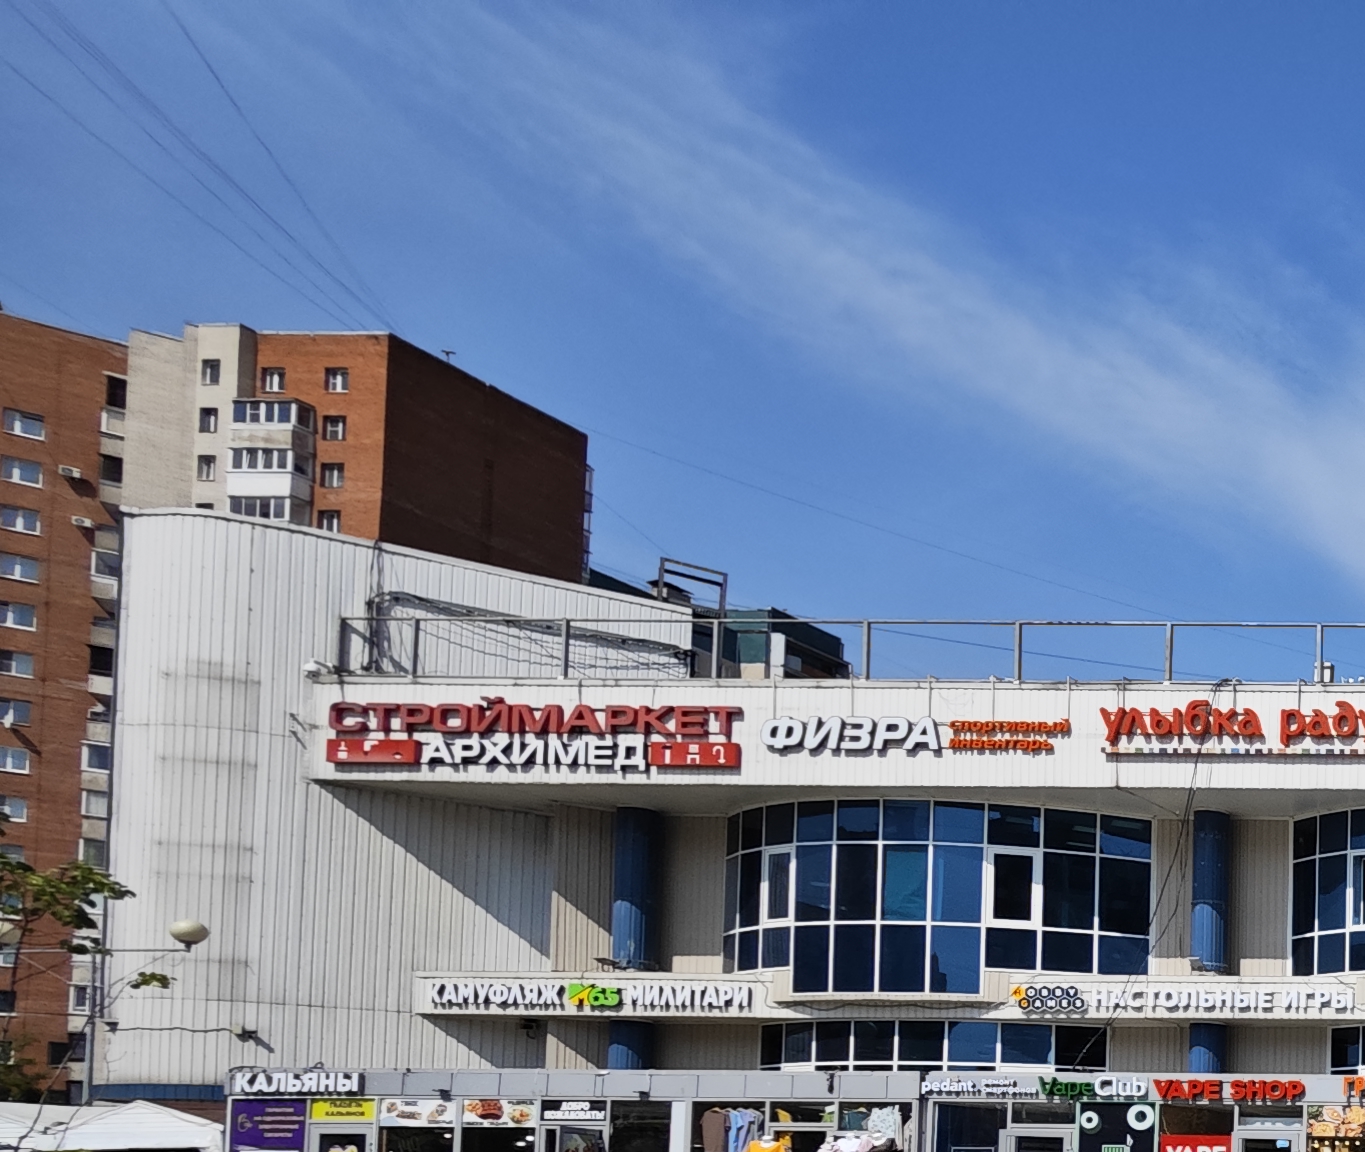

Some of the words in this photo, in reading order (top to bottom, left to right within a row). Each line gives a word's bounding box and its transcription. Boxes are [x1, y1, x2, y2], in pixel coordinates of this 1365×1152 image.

[328, 696, 743, 736] СТРОЙМАРКЕТ
[948, 718, 1071, 733] спортивный
[1100, 700, 1265, 744] улыбка
[760, 716, 940, 751] ФИЗРА
[948, 737, 1055, 751] инвентарь
[420, 739, 647, 771] АРХИМЕД
[430, 983, 566, 1006] КАМУФЛЯЖ
[626, 984, 752, 1007] МИЛИТАРИ
[1012, 987, 1078, 998] HOBBY
[1020, 998, 1083, 1008] GAMES
[1090, 987, 1275, 1011] НАСТОЛЬНЫЕ
[1283, 989, 1355, 1013] ИГРЫ
[235, 1072, 359, 1093] КАЛЬЯНЫ
[1152, 1079, 1220, 1099] VAPE
[1230, 1079, 1306, 1100] SHOP
